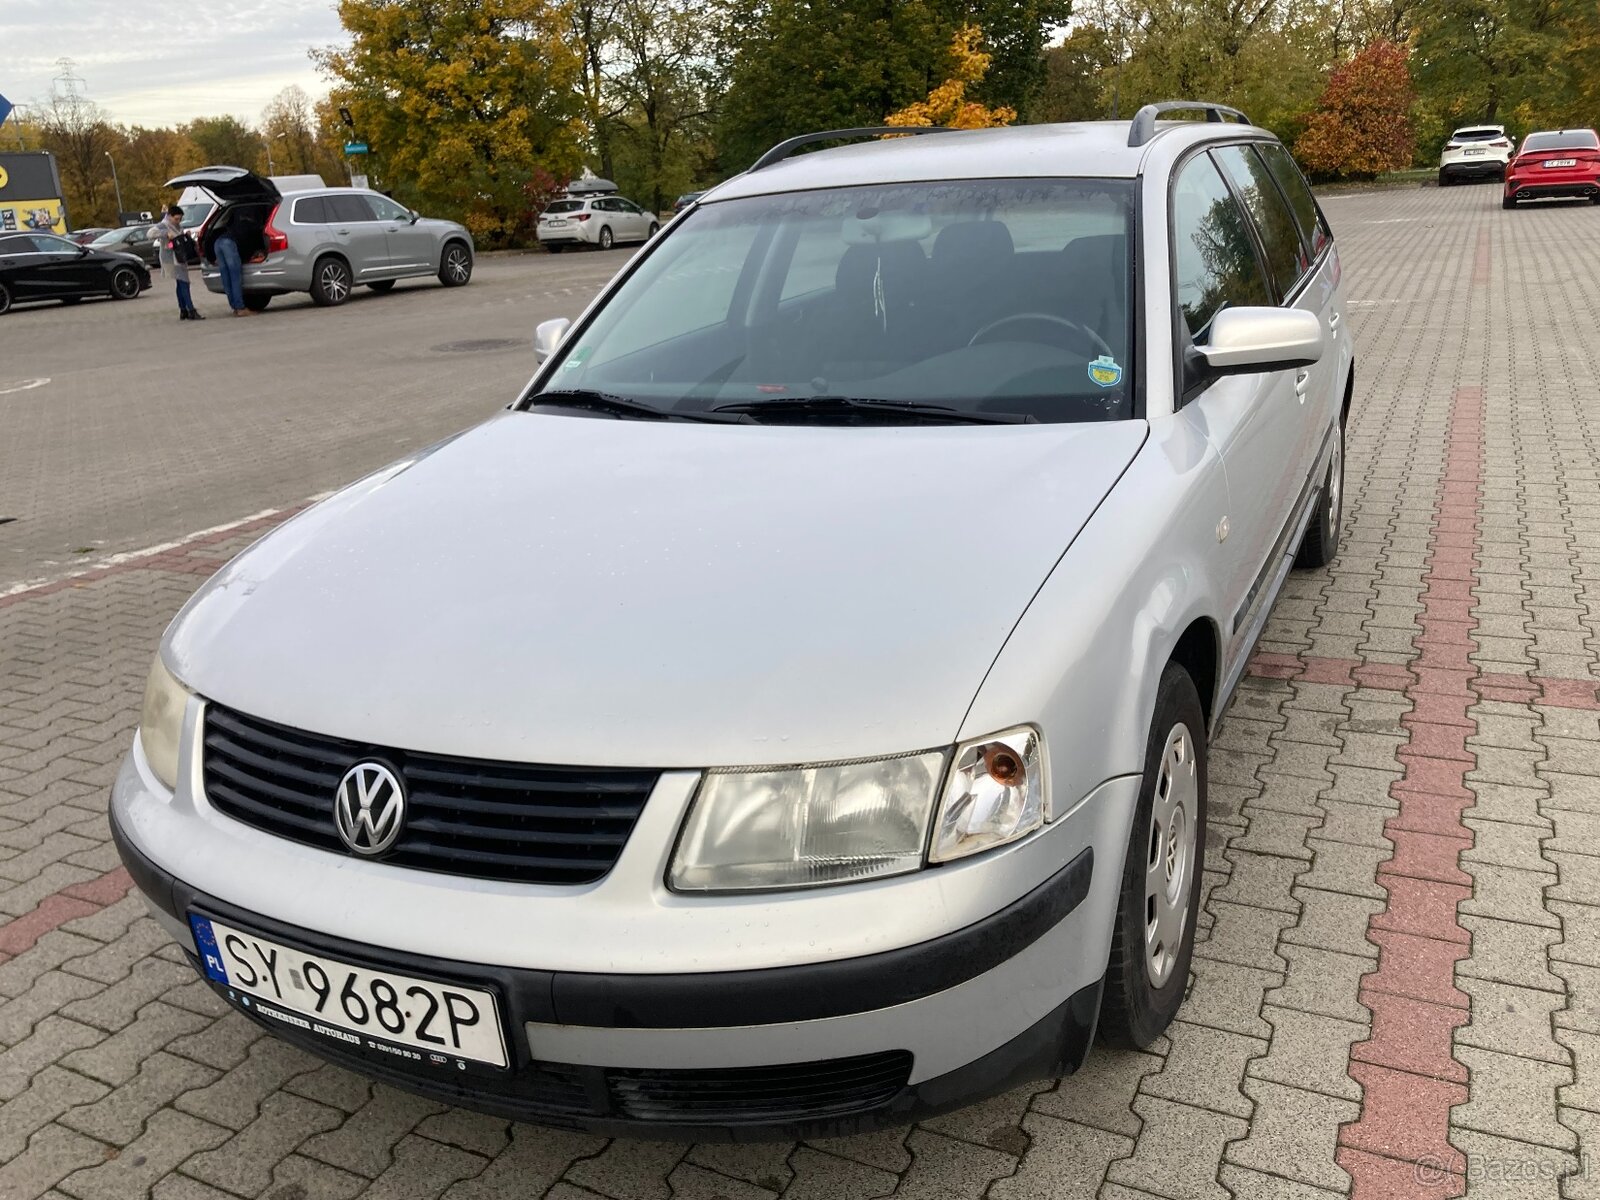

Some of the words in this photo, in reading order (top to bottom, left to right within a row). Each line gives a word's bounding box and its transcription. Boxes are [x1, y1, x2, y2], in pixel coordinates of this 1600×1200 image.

[206, 954, 224, 973] PL
[225, 934, 282, 999] SY
[303, 961, 480, 1049] 9682P
[313, 1023, 361, 1045] AUTOHAUS
